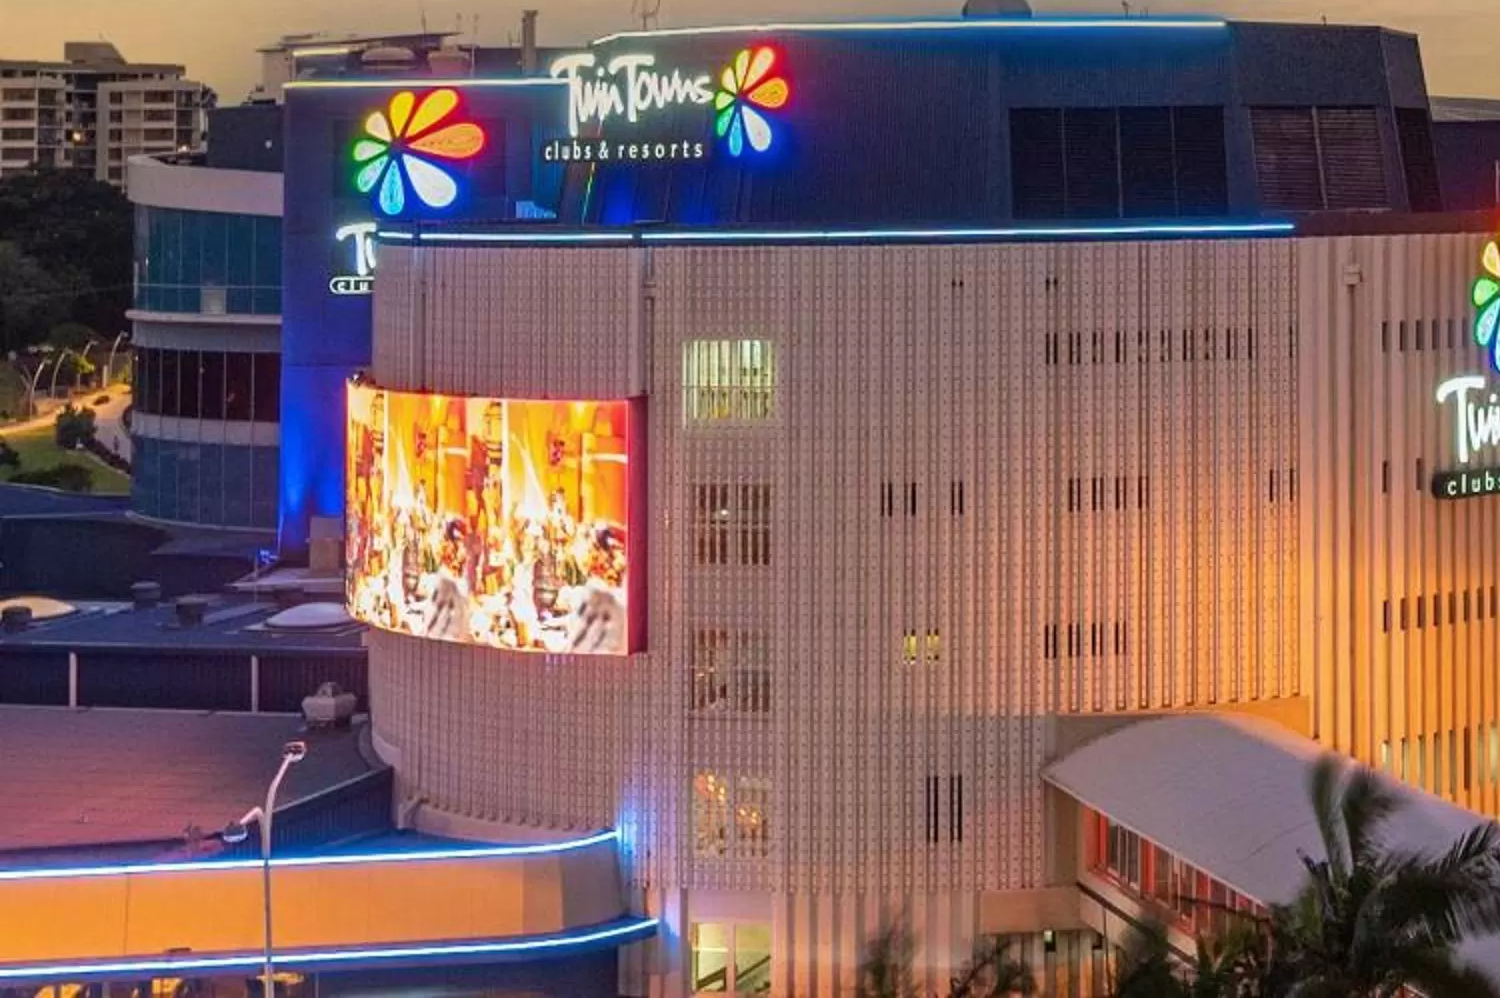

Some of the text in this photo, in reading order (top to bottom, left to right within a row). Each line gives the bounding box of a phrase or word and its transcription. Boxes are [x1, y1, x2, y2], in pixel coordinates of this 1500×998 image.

[550, 53, 714, 137] Twin Towns
[544, 139, 704, 161] clubs & resorts
